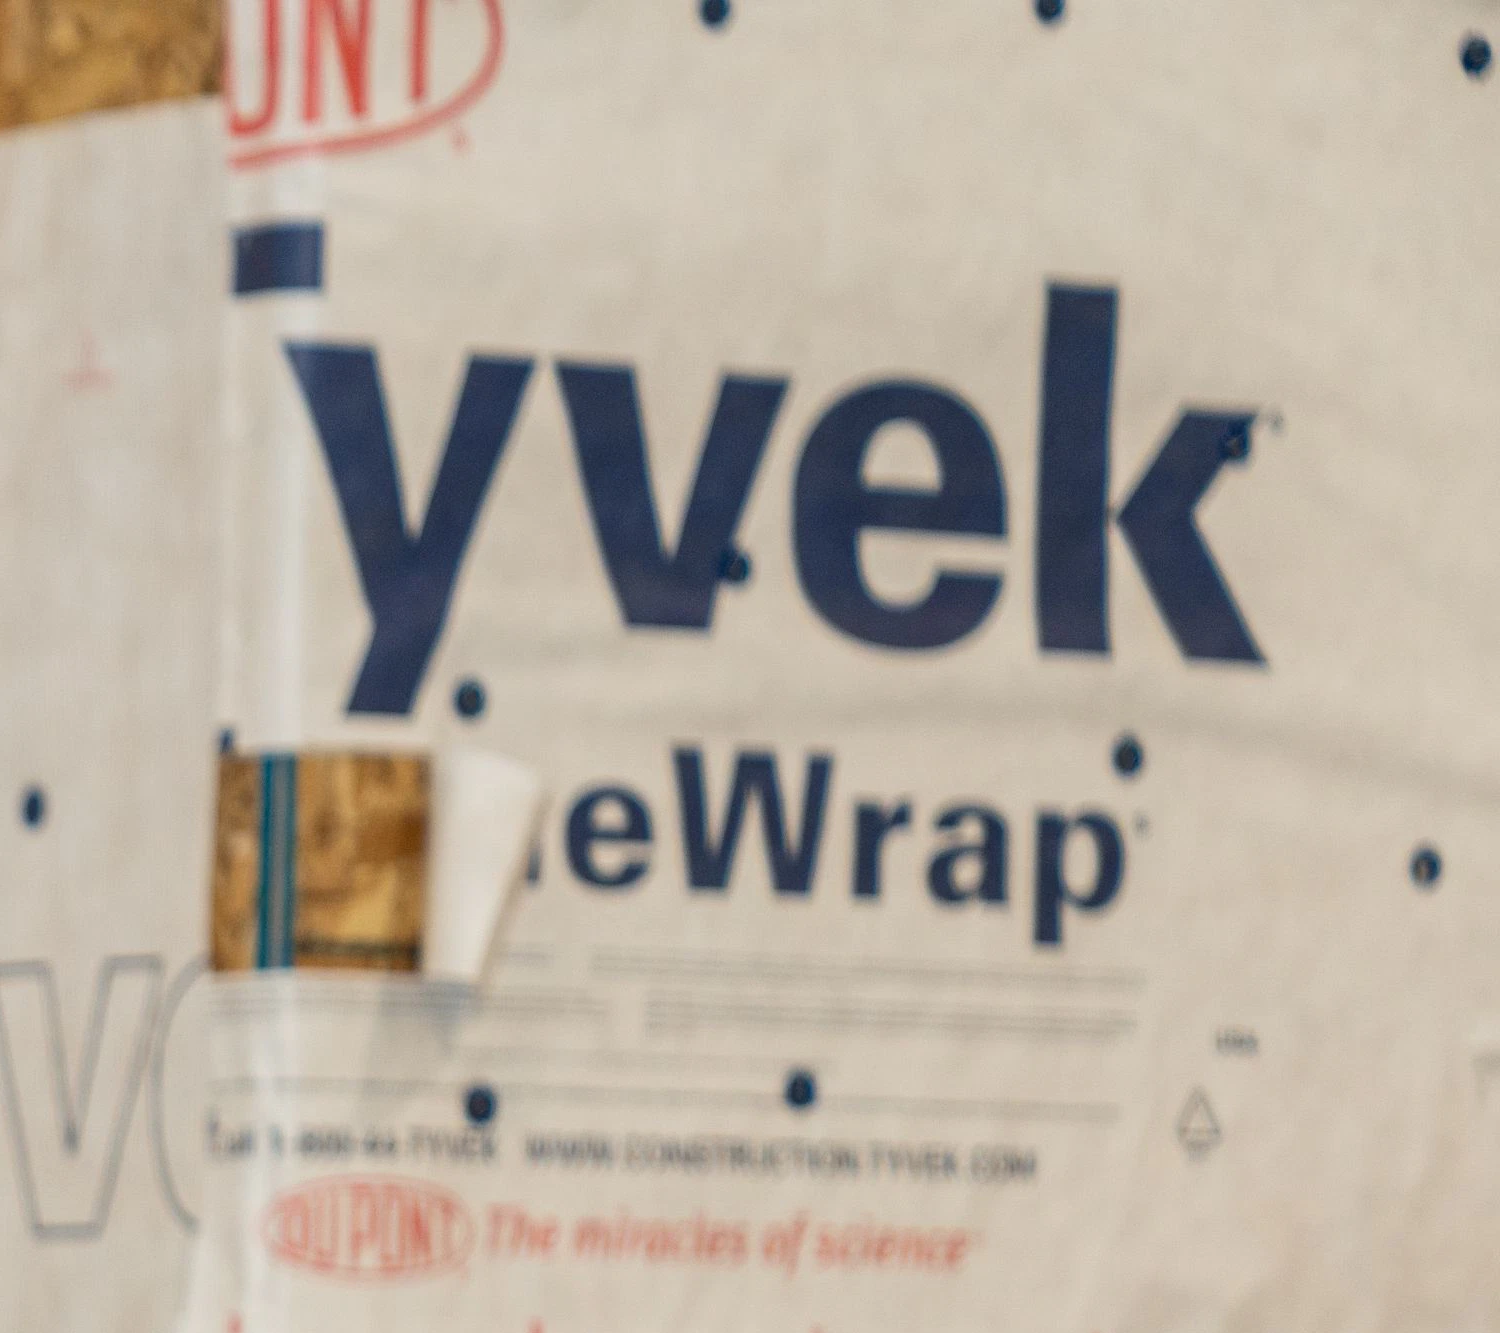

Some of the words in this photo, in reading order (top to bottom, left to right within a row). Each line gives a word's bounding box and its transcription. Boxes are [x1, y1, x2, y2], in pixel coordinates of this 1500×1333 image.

[232, 222, 1268, 718] yvek
[525, 745, 1130, 950] eWrap
[487, 1203, 560, 1260] The
[572, 1203, 748, 1266] miracles
[761, 1206, 811, 1280] of
[815, 1214, 970, 1274] science
